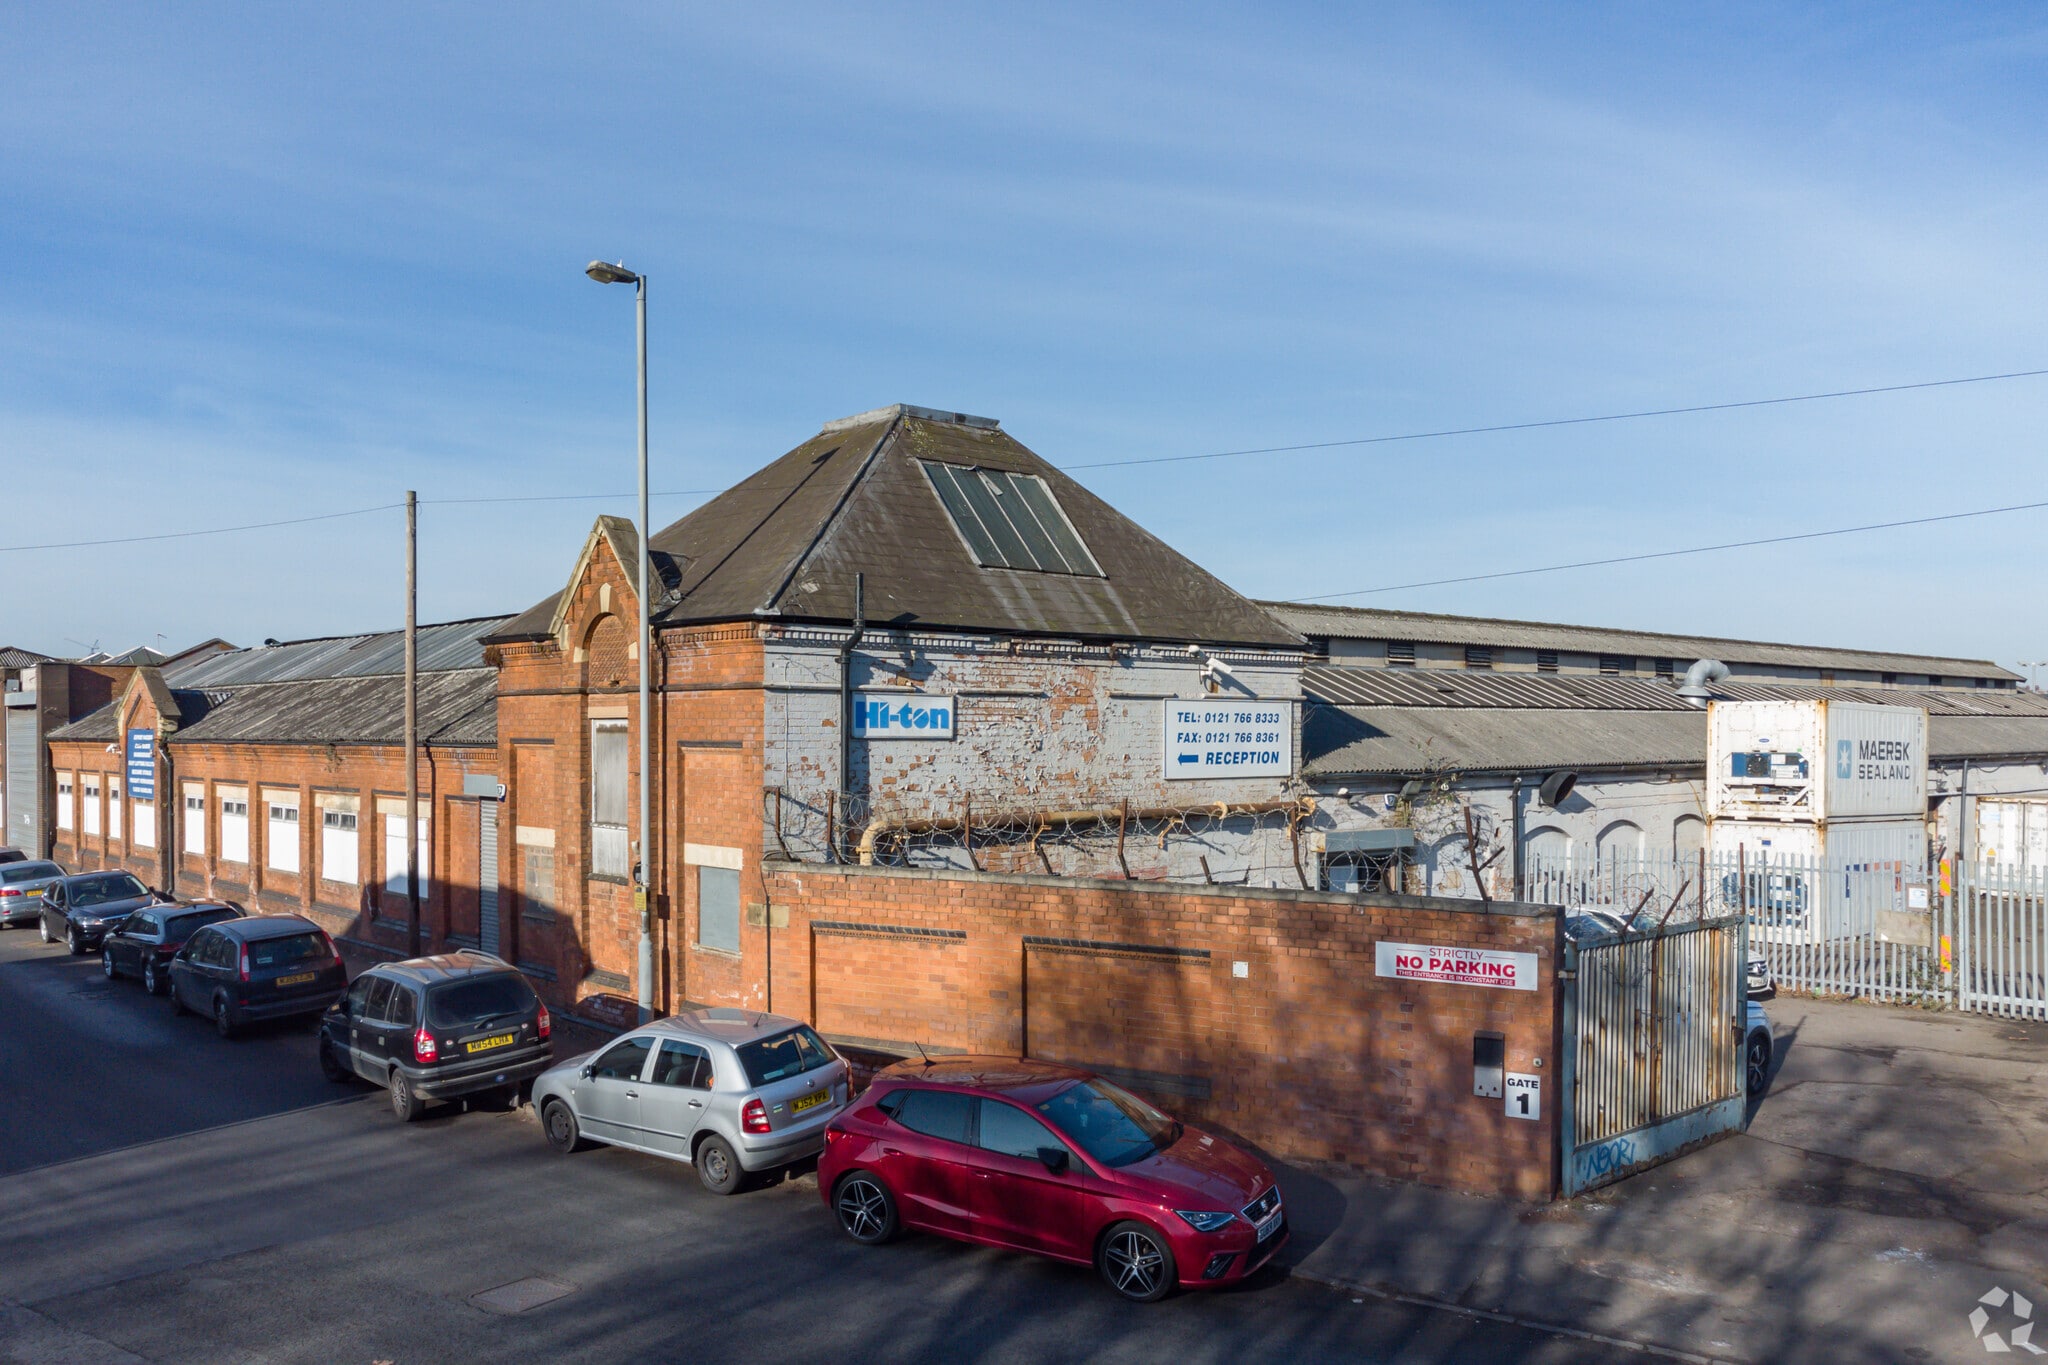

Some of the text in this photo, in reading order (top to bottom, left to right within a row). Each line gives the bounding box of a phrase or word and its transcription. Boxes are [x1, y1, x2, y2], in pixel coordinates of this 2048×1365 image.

[856, 701, 950, 729] Hi-ton
[1177, 712, 1280, 724] TEL: 0121 766 8333
[1177, 732, 1280, 743] FAX: 0121 766 8361
[1205, 751, 1280, 765] RECEPTION
[1859, 740, 1910, 761] MAERSK
[1858, 764, 1911, 780] SEALAND
[1429, 947, 1484, 960] STRICTLY
[1396, 955, 1516, 978] NO PARKING
[1413, 971, 1447, 980] ENTRANCE
[1448, 973, 1455, 981] IS
[1456, 974, 1463, 982] IN
[1464, 975, 1498, 985] CONSTANT
[1500, 978, 1514, 986] USE
[1507, 1078, 1539, 1089] GATE
[1516, 1093, 1529, 1115] 1
